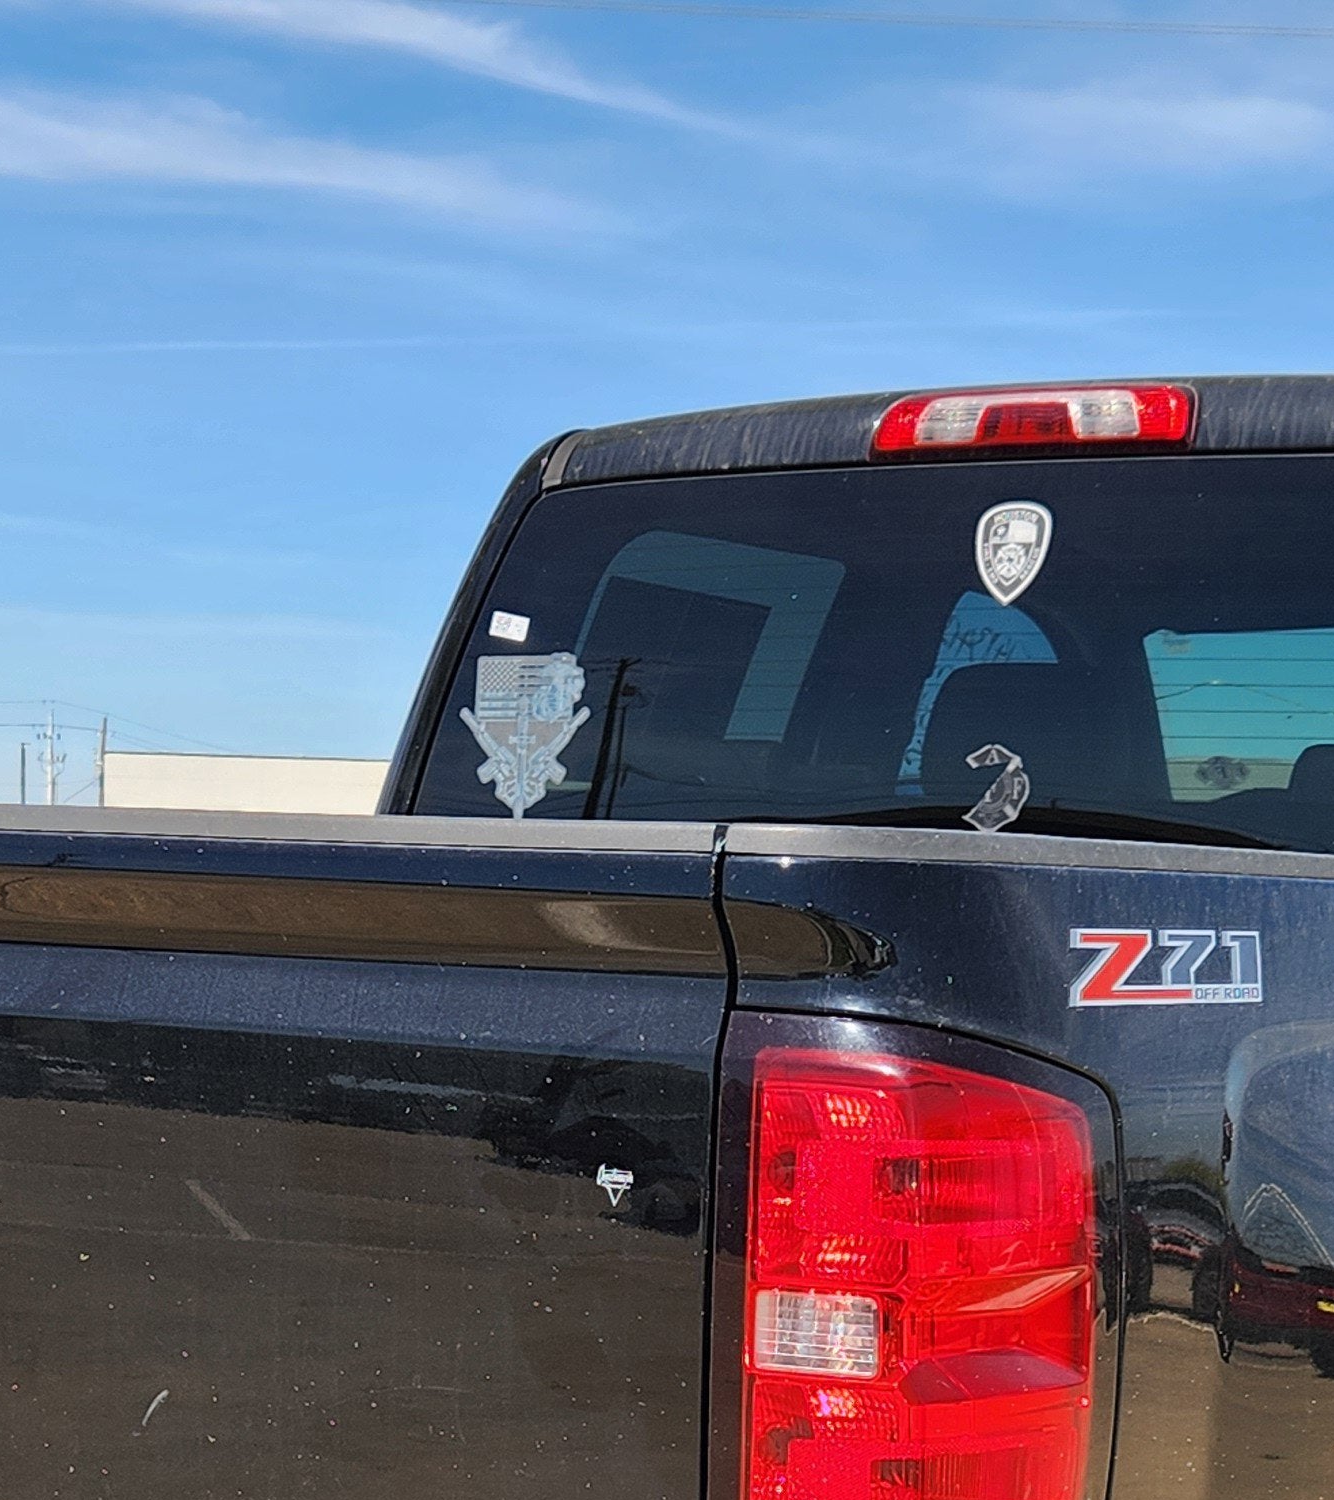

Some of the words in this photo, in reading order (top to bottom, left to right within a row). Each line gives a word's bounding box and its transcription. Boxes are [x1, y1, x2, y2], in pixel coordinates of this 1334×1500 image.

[1069, 928, 1263, 1006] Z71
[1194, 986, 1220, 1000] OFF
[1223, 986, 1260, 1000] ROAD
